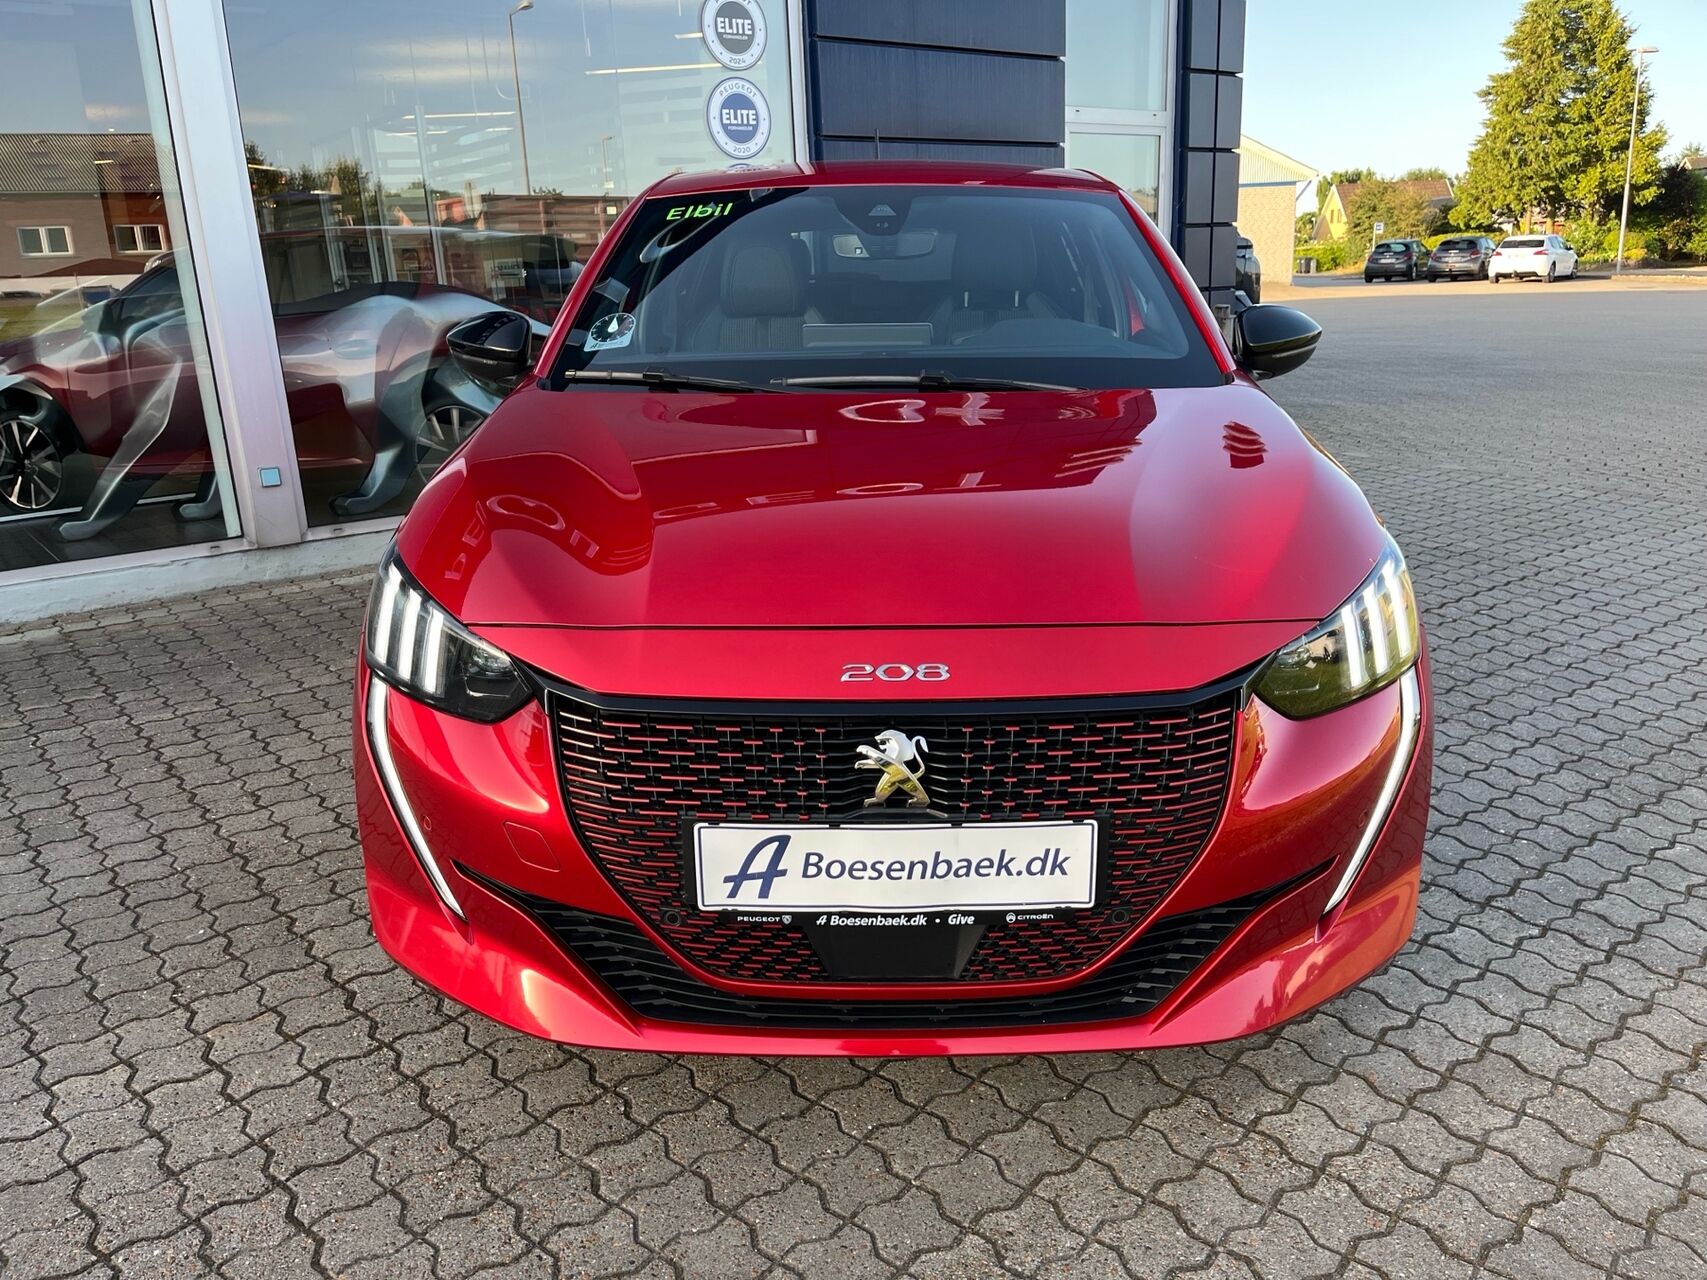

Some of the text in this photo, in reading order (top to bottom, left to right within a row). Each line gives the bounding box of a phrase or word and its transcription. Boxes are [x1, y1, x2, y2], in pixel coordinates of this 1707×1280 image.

[716, 16, 753, 35] ELITE
[729, 56, 746, 65] 2024
[719, 82, 757, 98] PEUGEOT
[721, 108, 757, 125] ELITE
[732, 146, 751, 154] 2020
[666, 202, 733, 221] Elbil
[840, 663, 951, 682] 208
[801, 847, 1071, 881] Boesenbaek.dk
[829, 914, 928, 927] Boesenbaek.dk
[947, 913, 975, 925] Give
